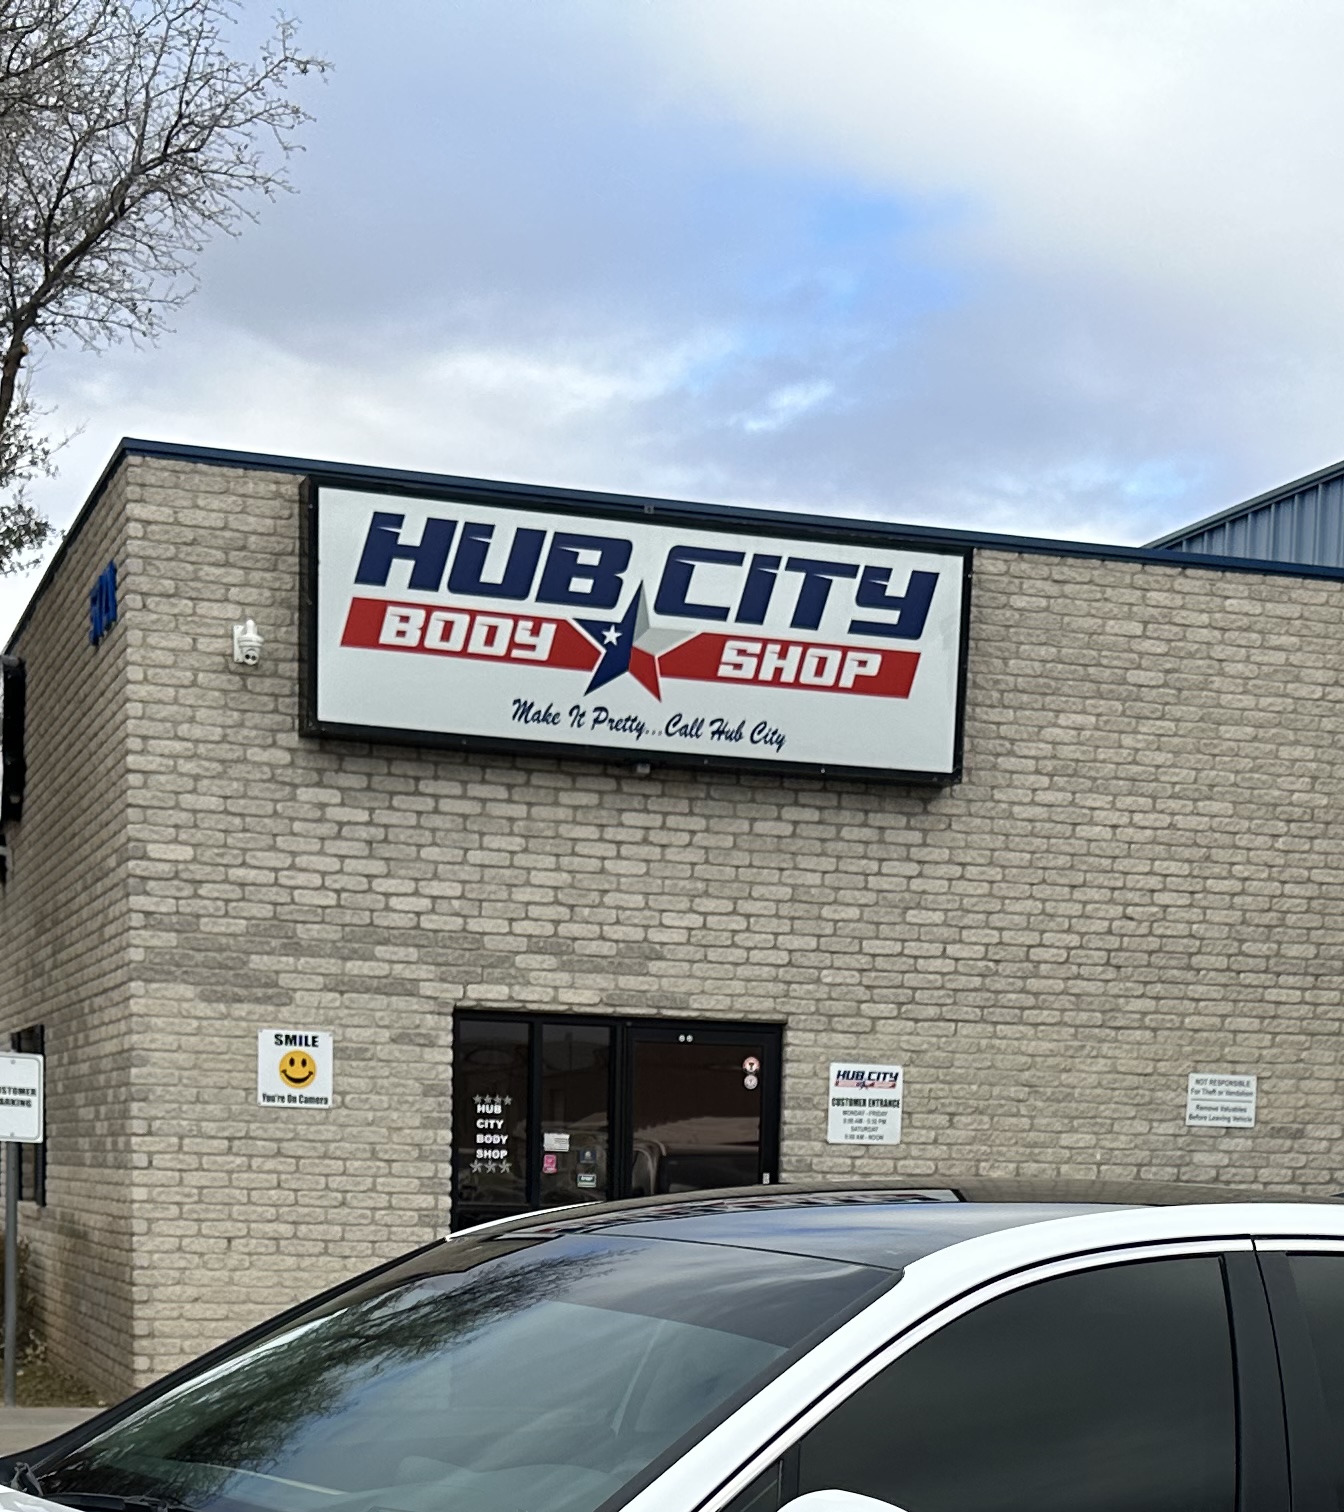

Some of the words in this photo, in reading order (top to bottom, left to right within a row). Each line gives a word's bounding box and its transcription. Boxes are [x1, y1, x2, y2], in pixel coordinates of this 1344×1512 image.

[354, 511, 633, 609] HUB
[653, 545, 940, 640] CITY
[378, 605, 560, 661] BODY
[717, 641, 882, 690] SHOP
[512, 699, 561, 726] Make
[568, 704, 586, 728] It
[709, 718, 746, 742] Hub
[750, 720, 788, 753] City
[274, 1033, 319, 1048] SMILE
[836, 1070, 865, 1081] HUB
[867, 1071, 899, 1082] CITY
[262, 1092, 286, 1104] You're
[287, 1093, 298, 1104] On
[299, 1094, 329, 1105] Camera
[831, 1097, 867, 1107] CUSTOMER
[868, 1098, 900, 1108] ENTRANCE
[476, 1104, 502, 1114] HUB
[476, 1118, 504, 1130] CITY
[476, 1133, 508, 1145] BODY
[476, 1148, 508, 1160] SHOP
